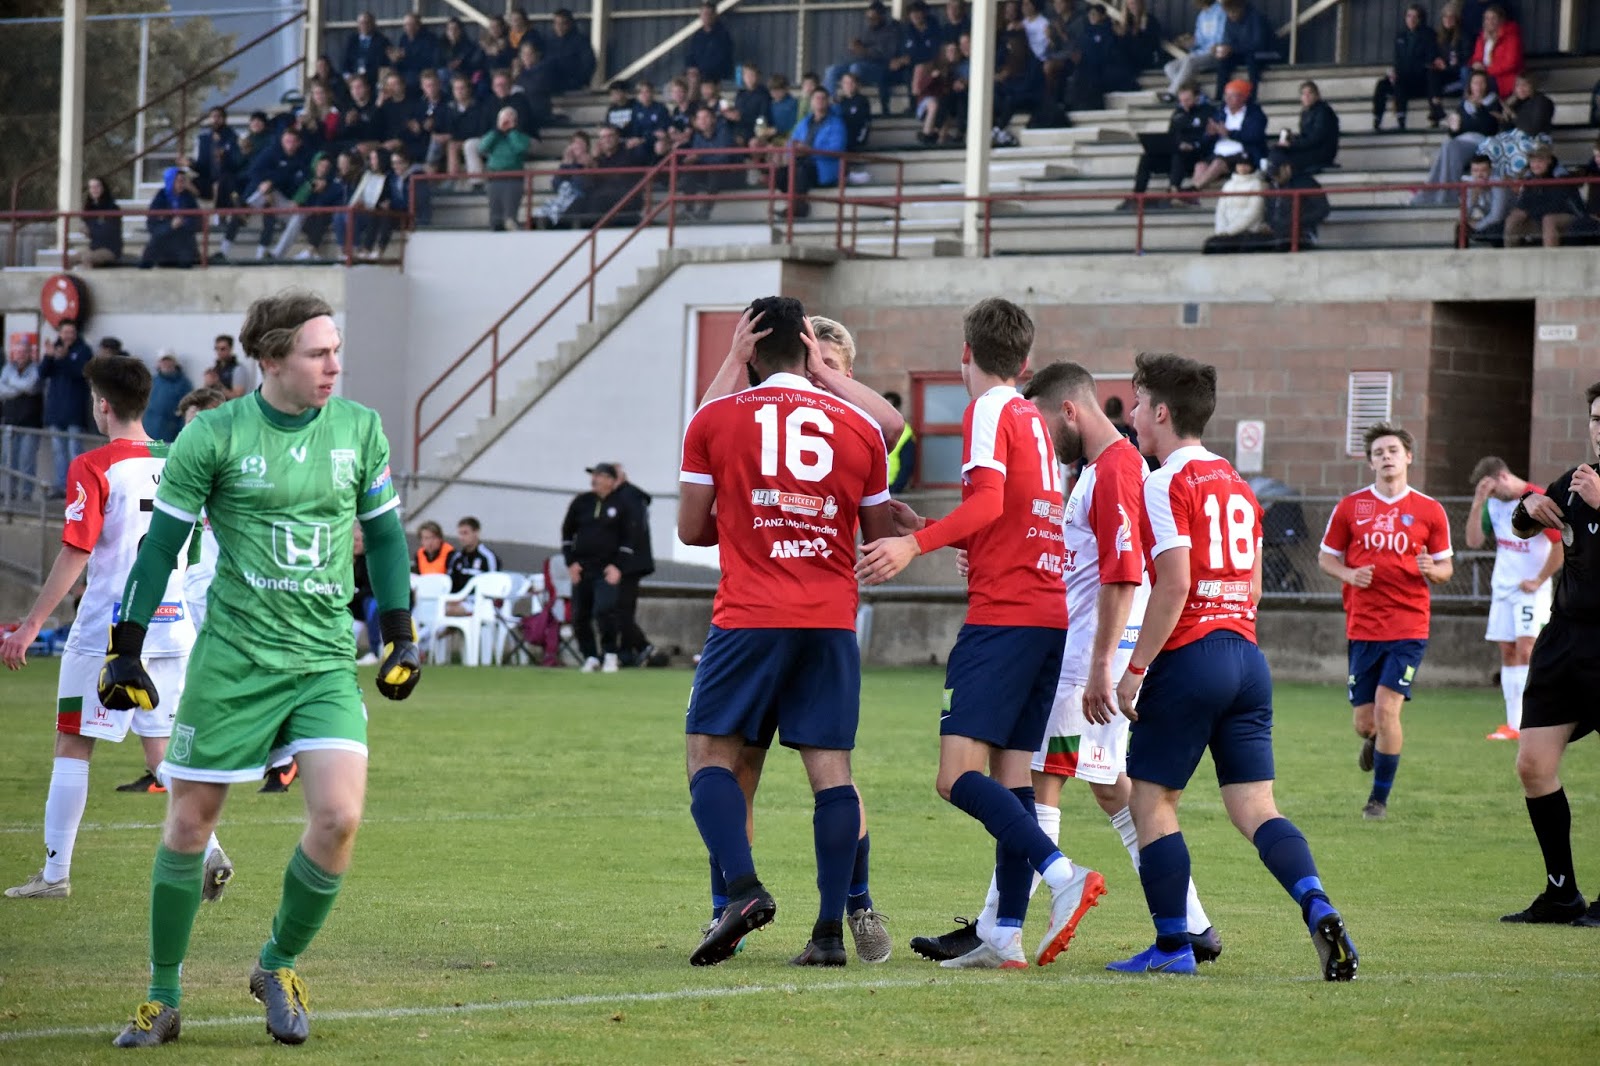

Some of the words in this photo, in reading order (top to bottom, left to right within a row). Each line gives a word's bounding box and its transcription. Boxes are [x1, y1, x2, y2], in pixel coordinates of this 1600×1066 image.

[736, 393, 784, 404] Richmond
[786, 393, 817, 406] Village
[819, 399, 845, 414] Store
[755, 403, 834, 482] 16
[783, 495, 816, 507] CHICKEN
[764, 518, 784, 527] ANZ
[1204, 494, 1256, 570] 18
[769, 540, 816, 559] ANZ
[1363, 531, 1409, 555] 1910
[244, 571, 299, 592] Honda
[1521, 606, 1534, 622] 5
